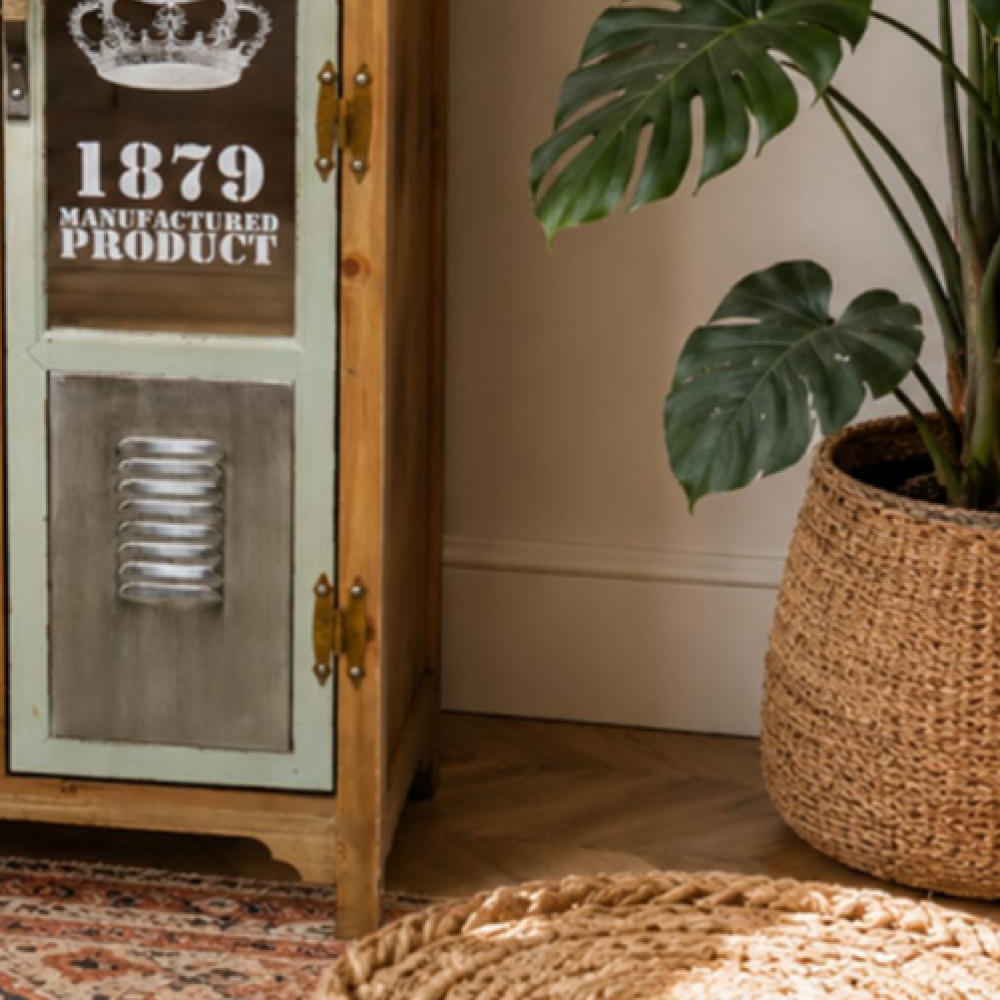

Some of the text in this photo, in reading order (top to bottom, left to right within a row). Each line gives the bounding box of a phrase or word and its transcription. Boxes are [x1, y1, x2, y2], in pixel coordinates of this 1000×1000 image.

[76, 141, 265, 203] 1879
[59, 206, 279, 232] MANUFACTURED
[60, 228, 278, 266] PRODUCT
